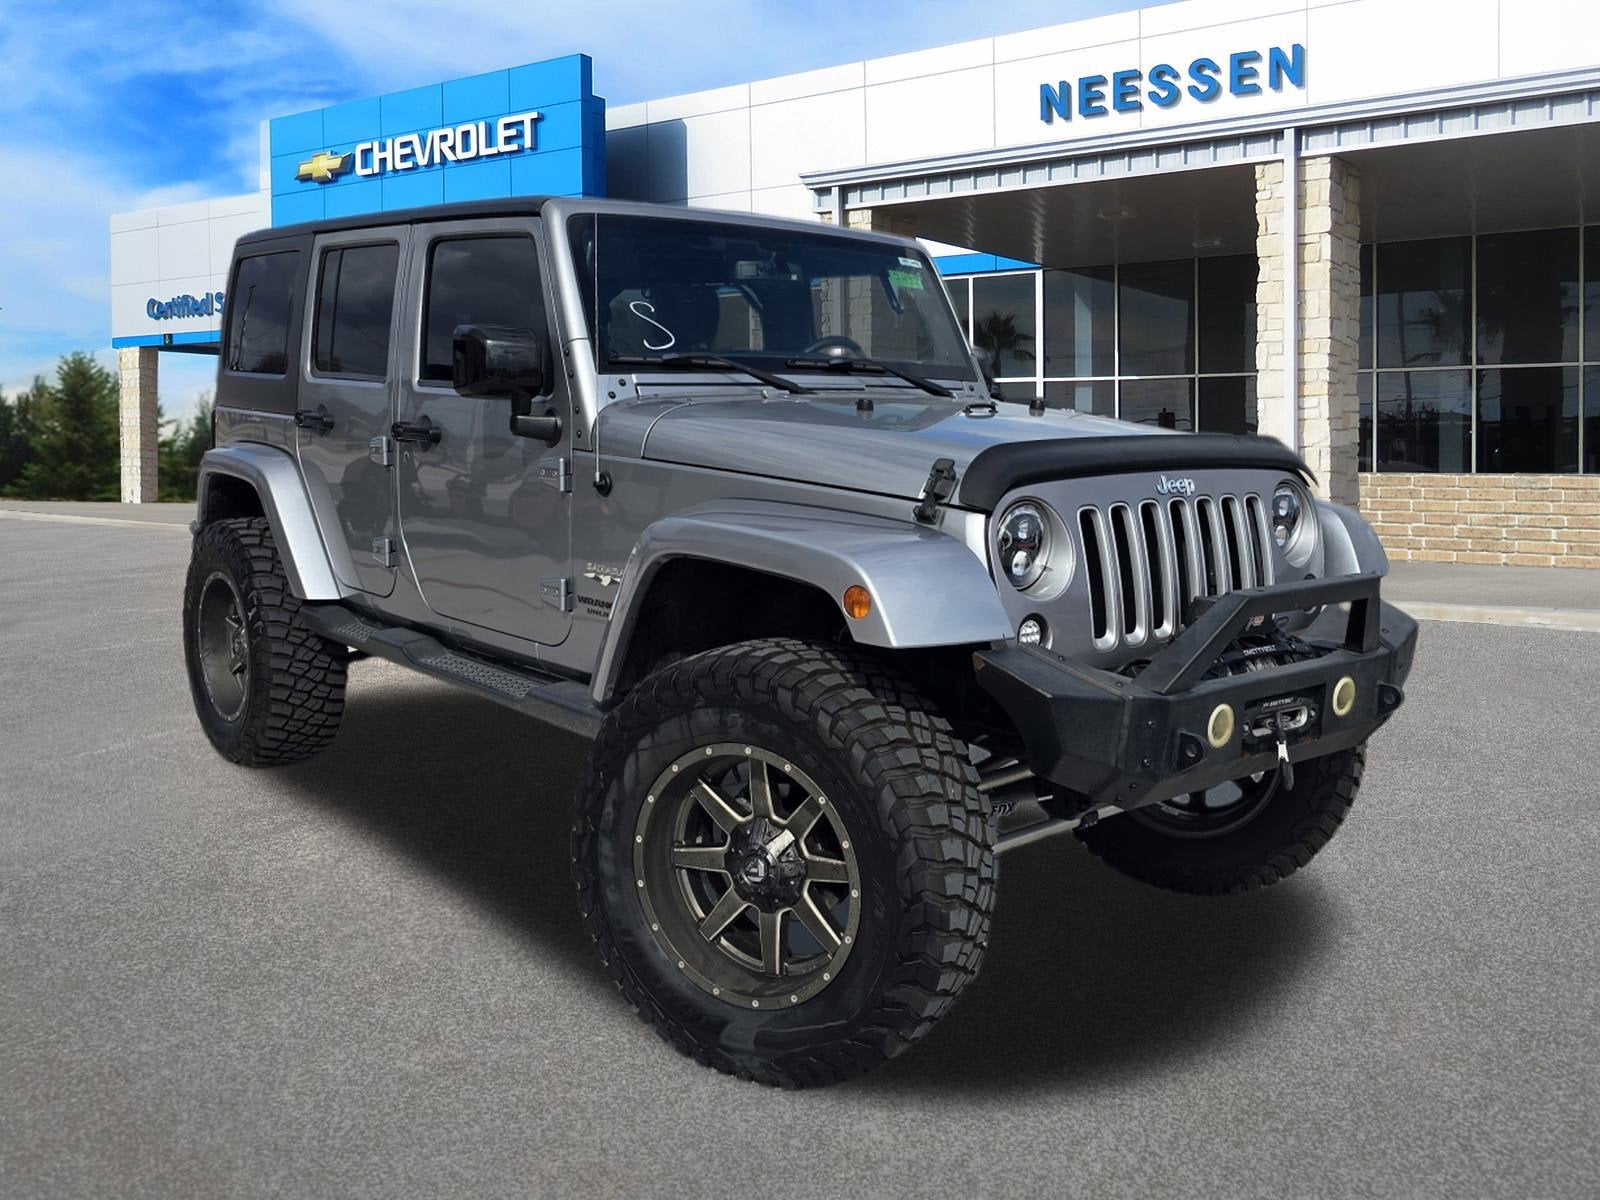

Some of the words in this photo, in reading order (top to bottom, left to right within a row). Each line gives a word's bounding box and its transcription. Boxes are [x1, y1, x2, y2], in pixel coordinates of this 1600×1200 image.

[1040, 43, 1305, 125] NEESSEN
[354, 111, 543, 178] CHEVROLET
[147, 292, 214, 320] Certified
[629, 301, 676, 350] S
[1155, 474, 1196, 497] Jeep
